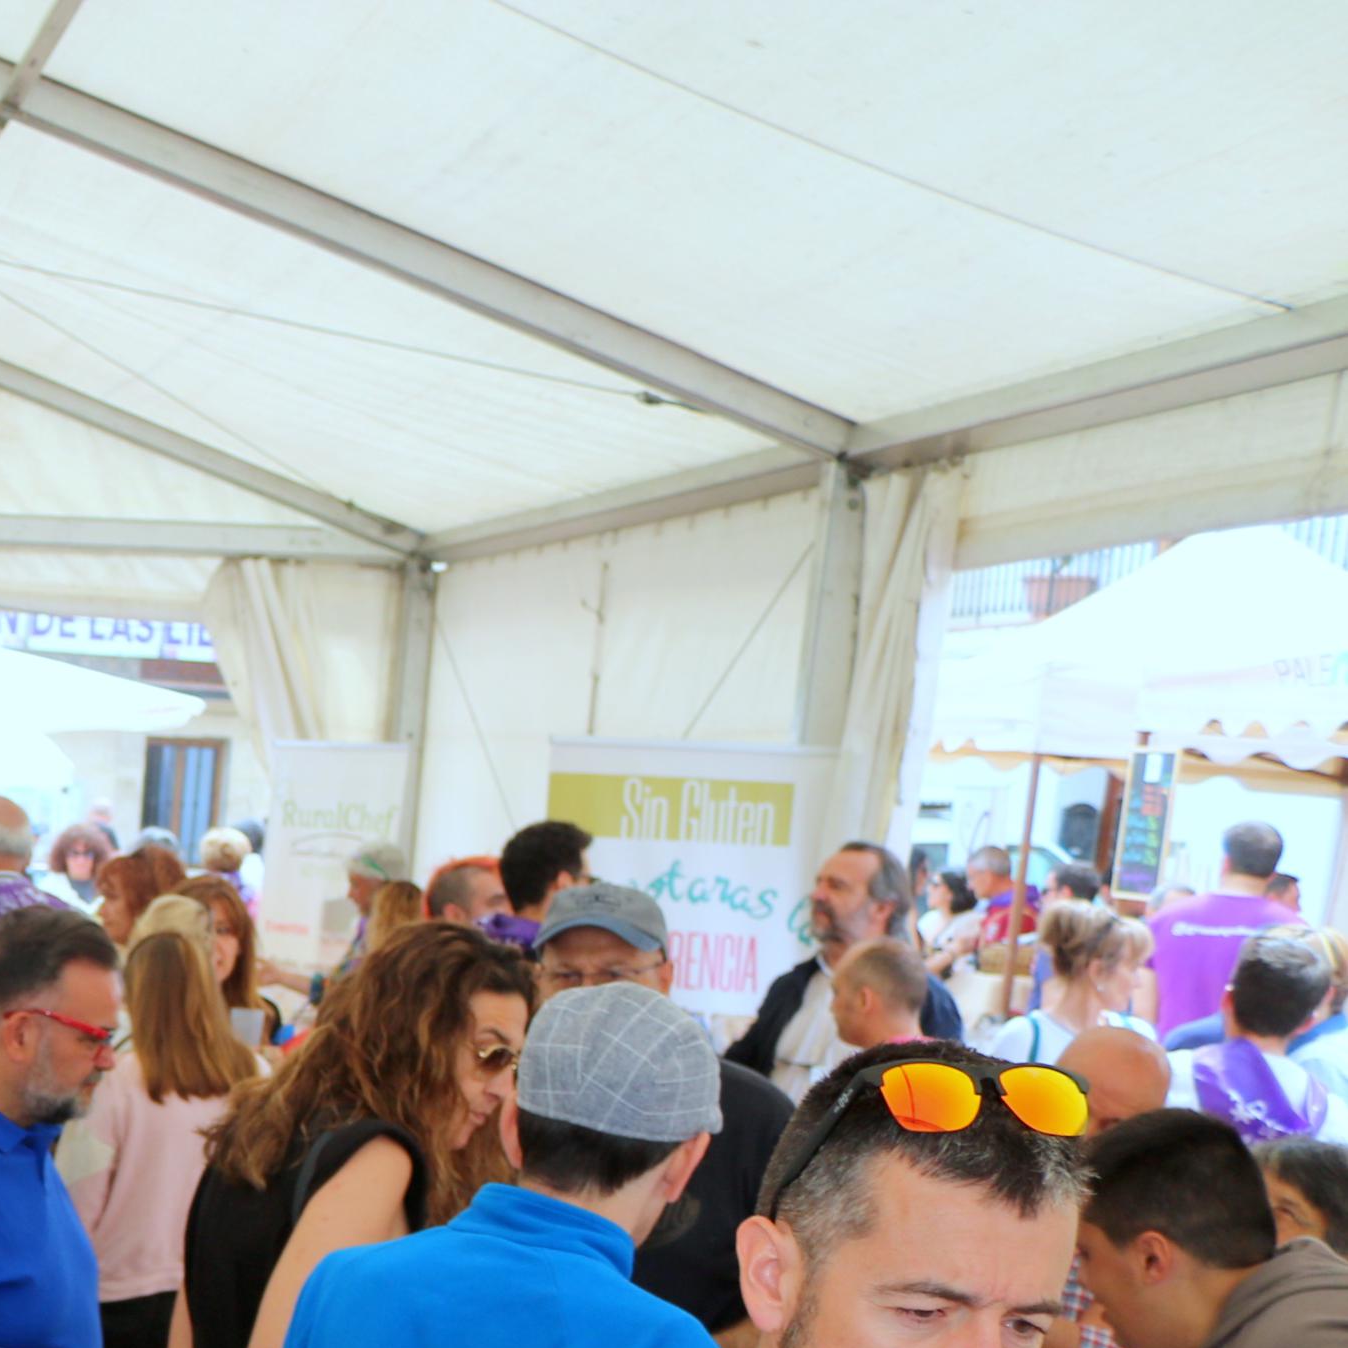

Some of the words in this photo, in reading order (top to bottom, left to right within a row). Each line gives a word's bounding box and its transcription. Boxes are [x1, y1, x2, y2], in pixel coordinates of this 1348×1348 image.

[620, 777, 671, 841] Sin
[679, 779, 775, 846] Gluten
[668, 931, 759, 993] RENCIA
